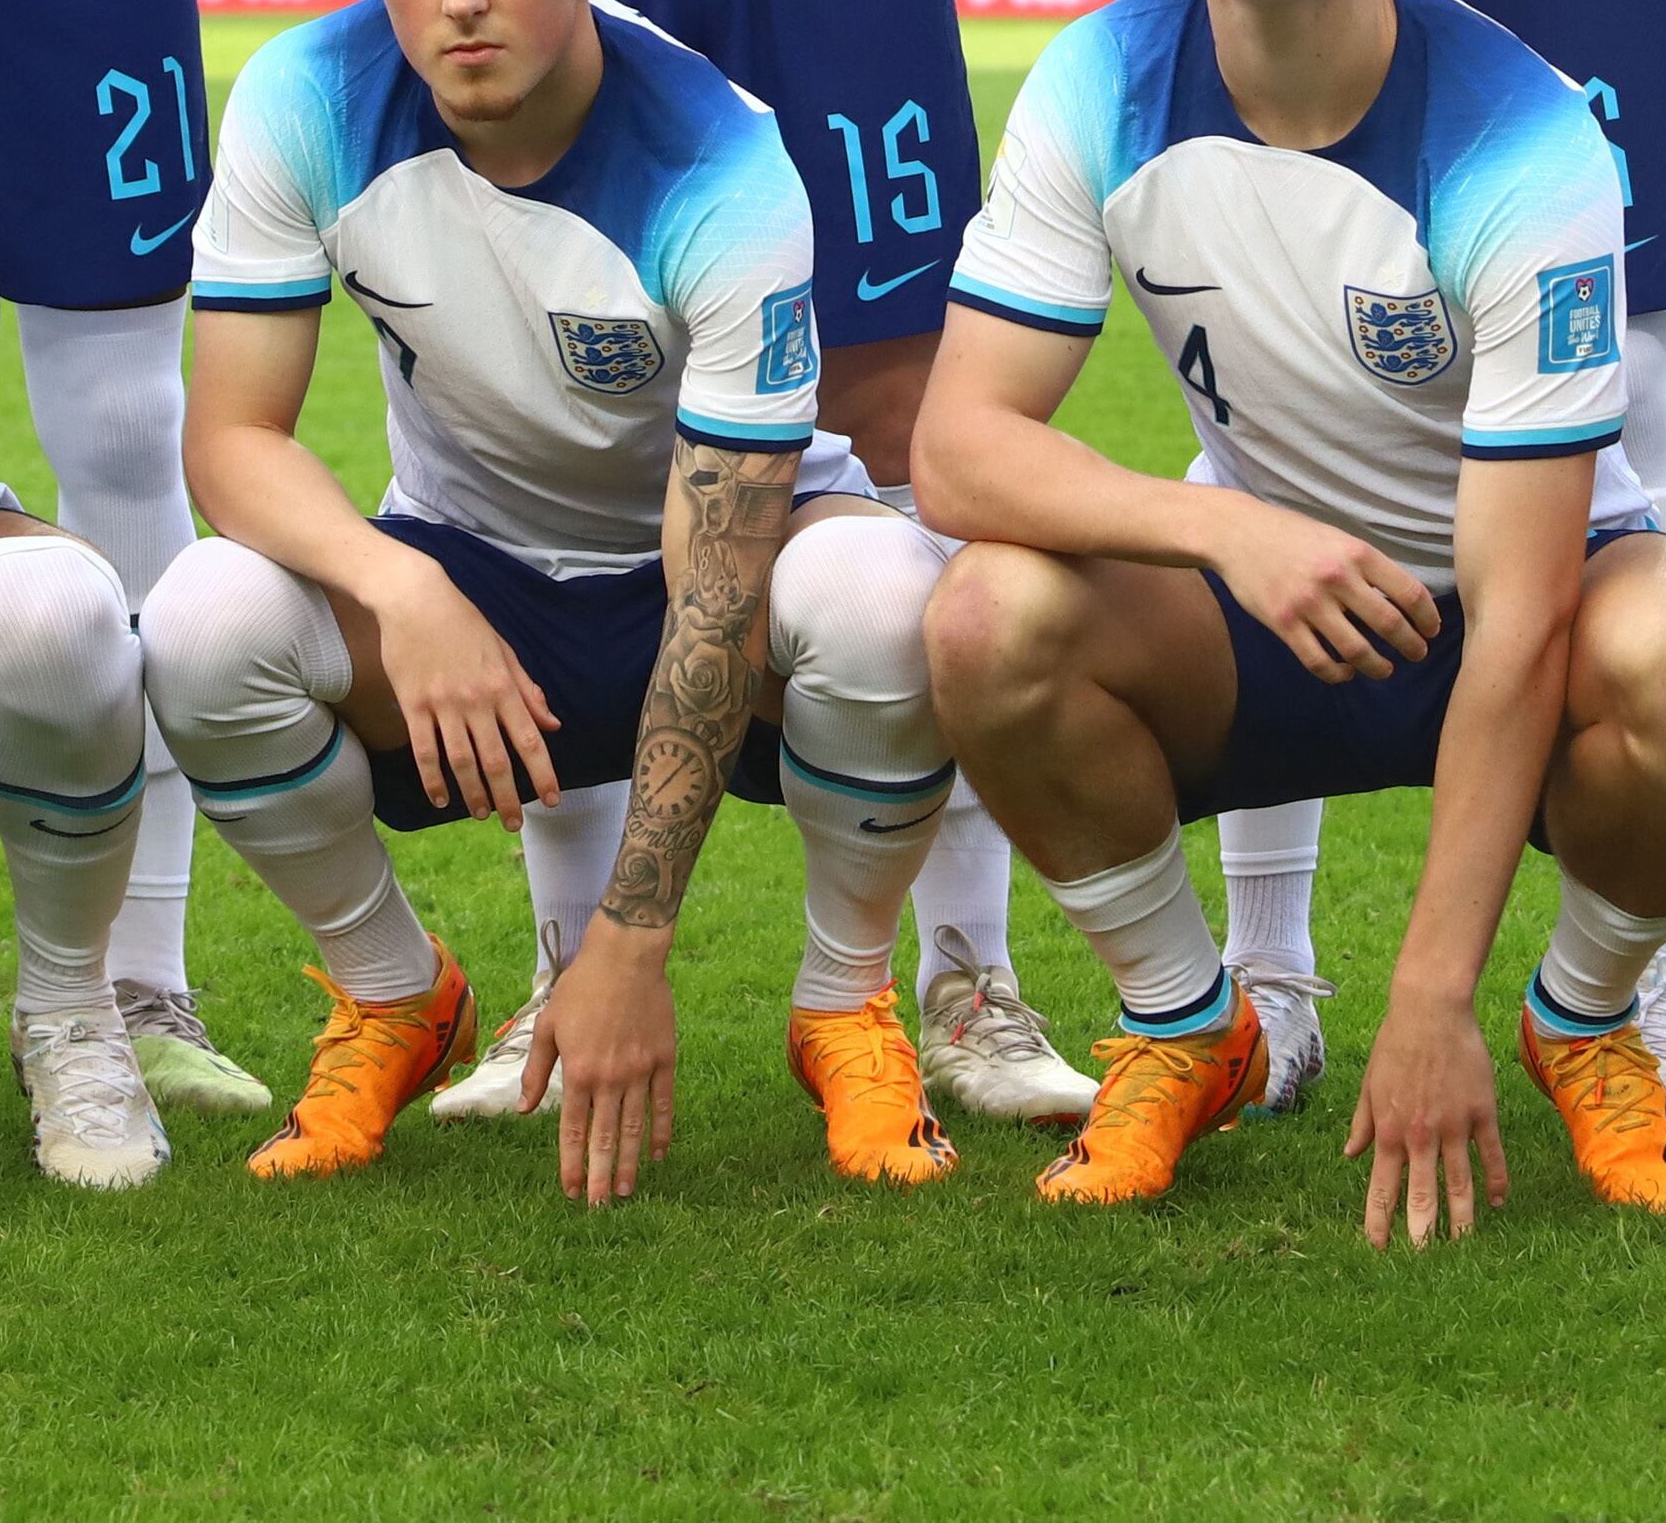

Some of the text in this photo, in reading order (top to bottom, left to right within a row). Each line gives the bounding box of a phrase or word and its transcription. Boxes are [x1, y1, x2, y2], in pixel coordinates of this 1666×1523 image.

[95, 54, 196, 201] 21
[826, 98, 944, 244] 15
[1178, 324, 1233, 427] 4
[1569, 315, 1602, 333] UNITES
